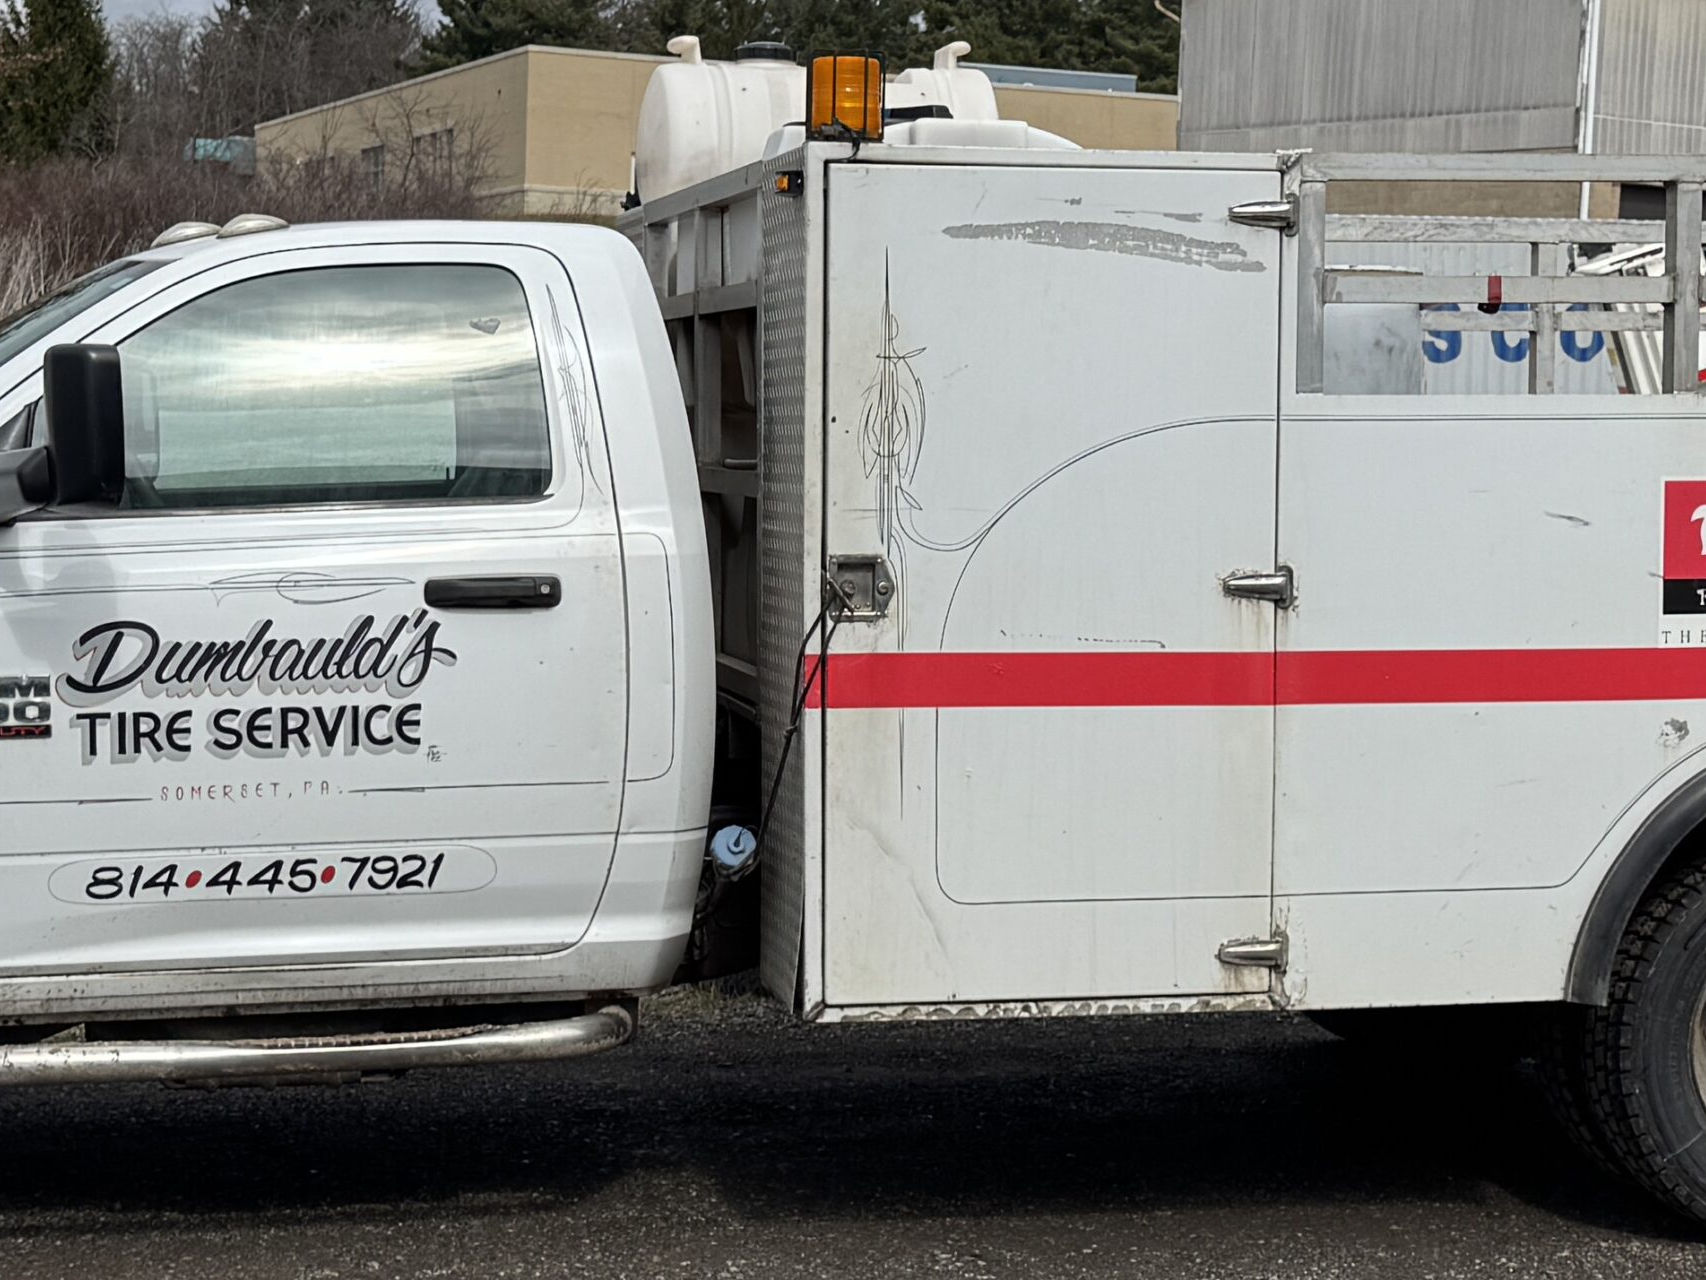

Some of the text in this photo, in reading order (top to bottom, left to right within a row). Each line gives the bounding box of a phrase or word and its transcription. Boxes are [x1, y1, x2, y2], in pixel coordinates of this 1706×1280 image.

[62, 609, 457, 700] Dumbauld's
[73, 703, 422, 760] TIRE SERVICE
